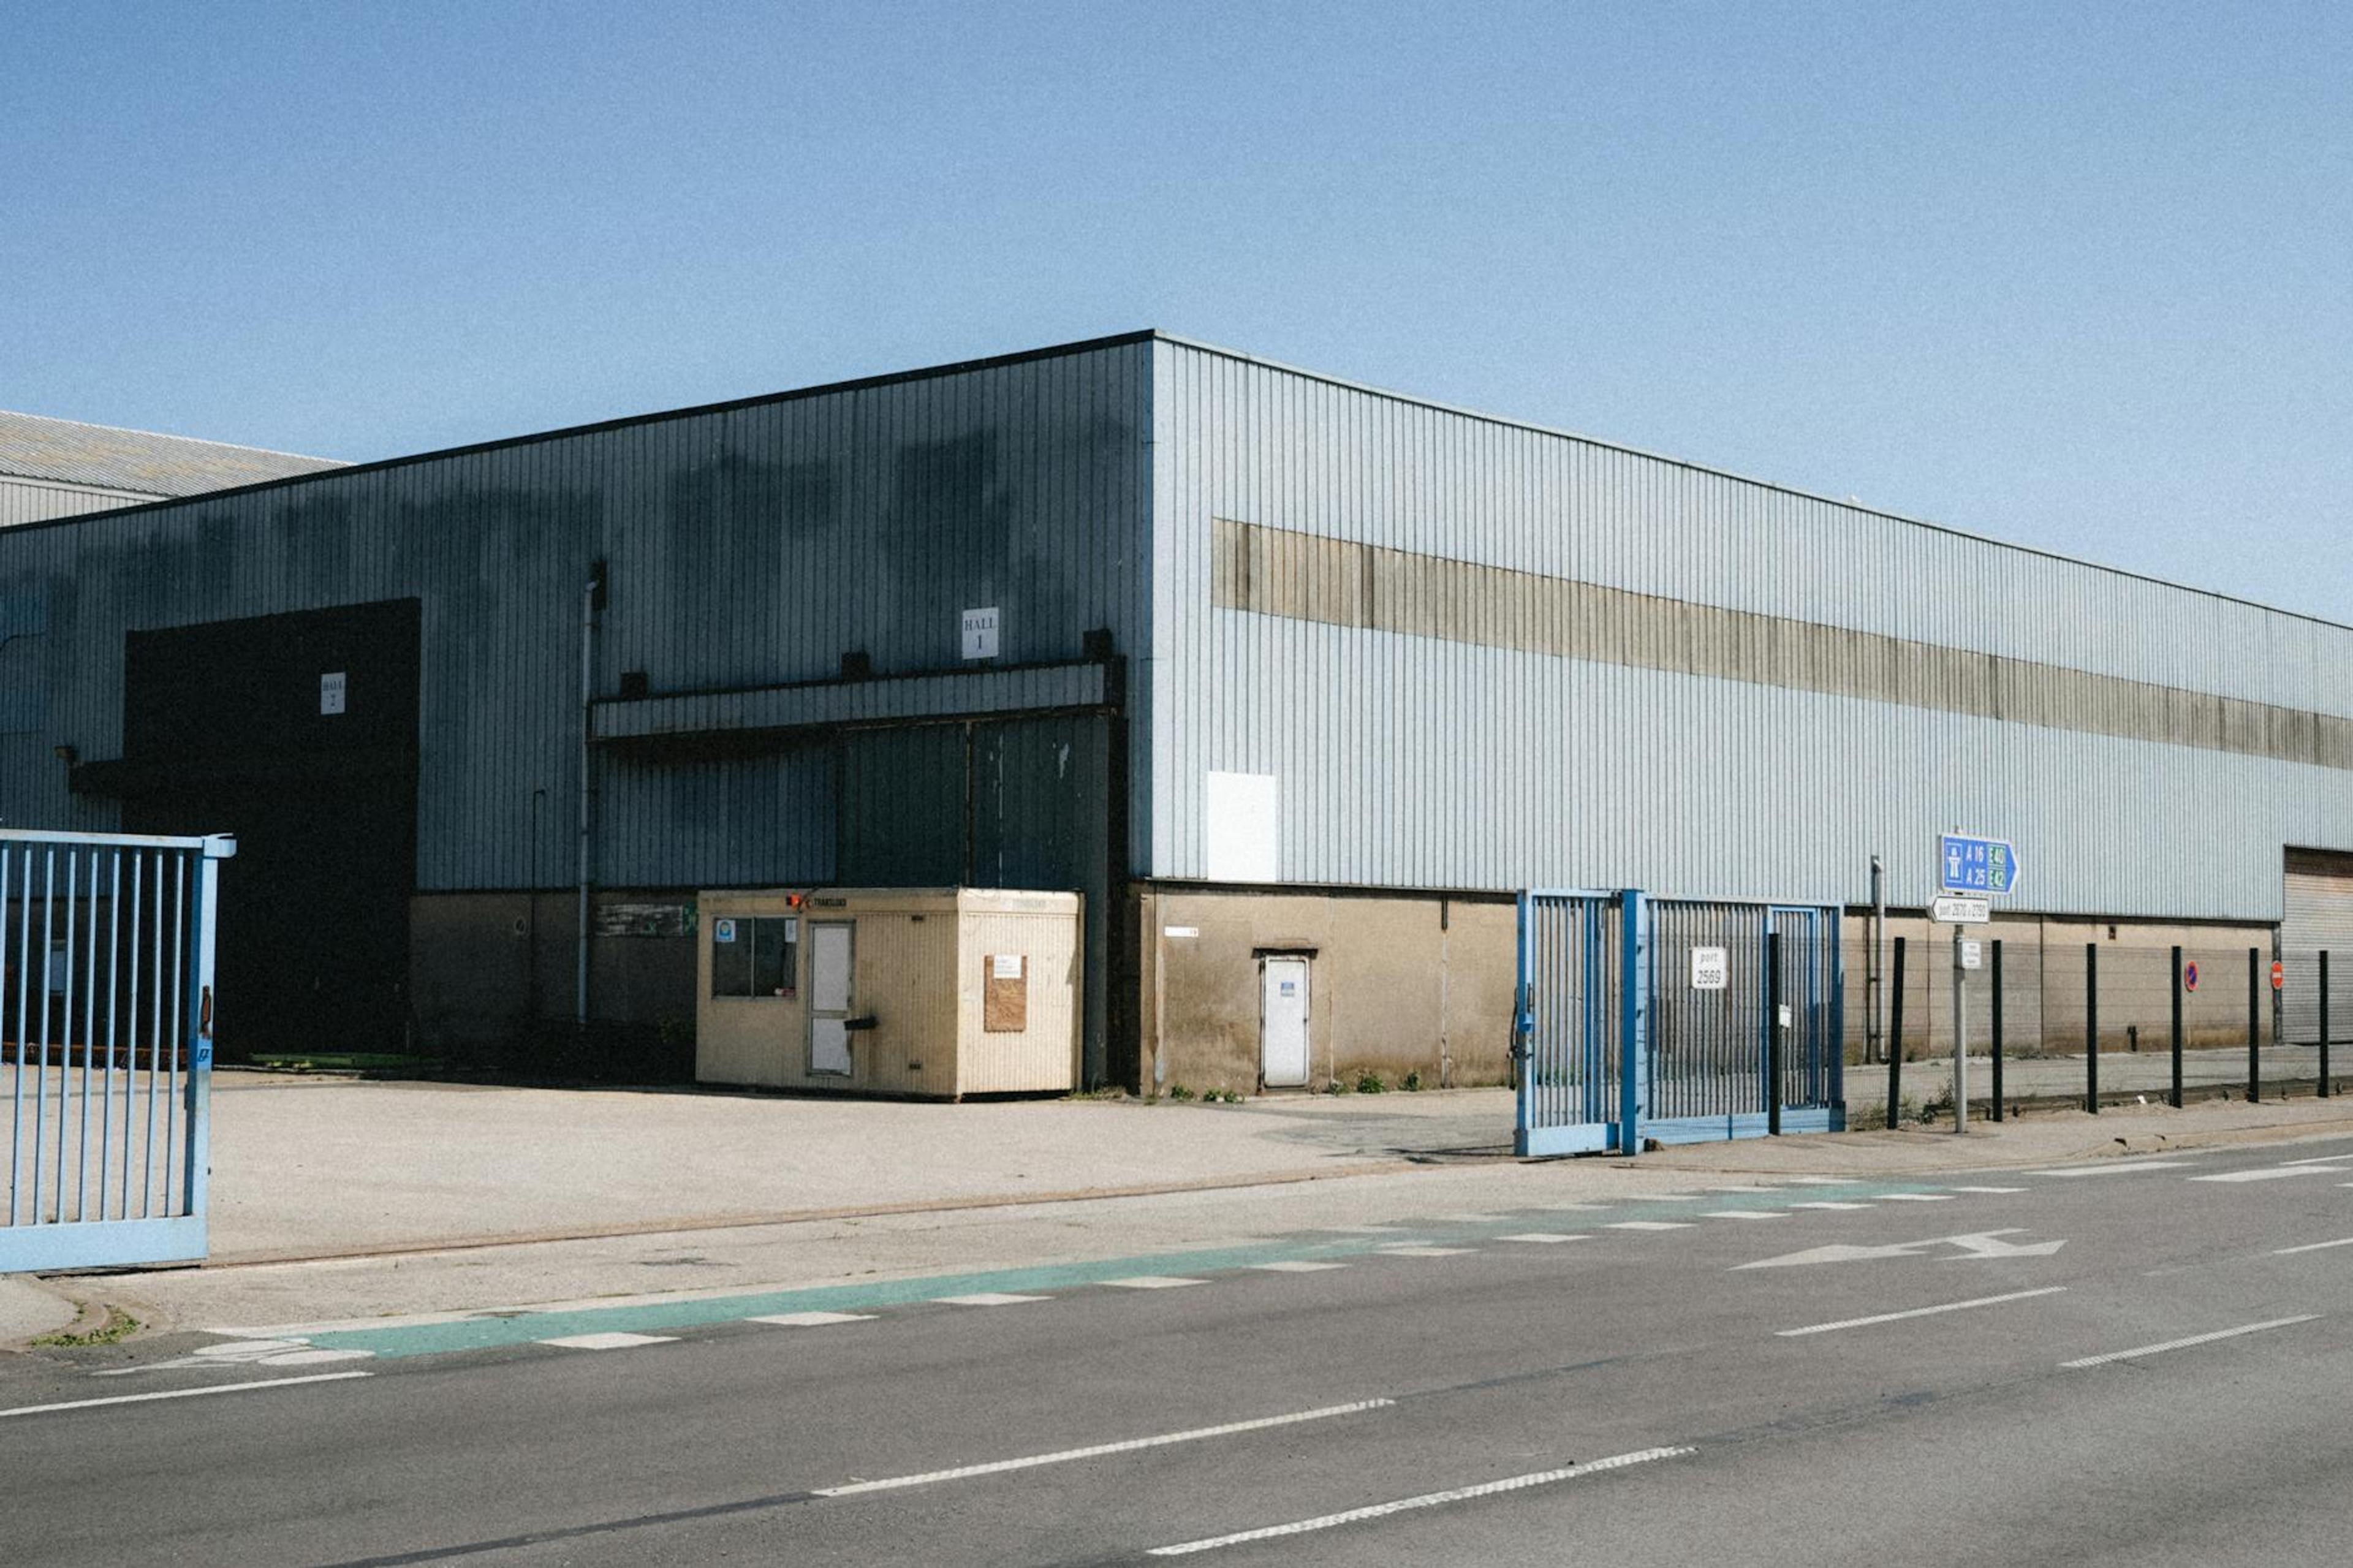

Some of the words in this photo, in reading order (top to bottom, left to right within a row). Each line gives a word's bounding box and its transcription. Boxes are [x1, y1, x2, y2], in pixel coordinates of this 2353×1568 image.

[964, 617, 995, 631] HALL
[1966, 844, 1972, 862] A
[1975, 846, 1984, 863] 16
[1966, 867, 1972, 885] A
[1974, 868, 1985, 886] 25
[1697, 969, 1721, 984] 2569
